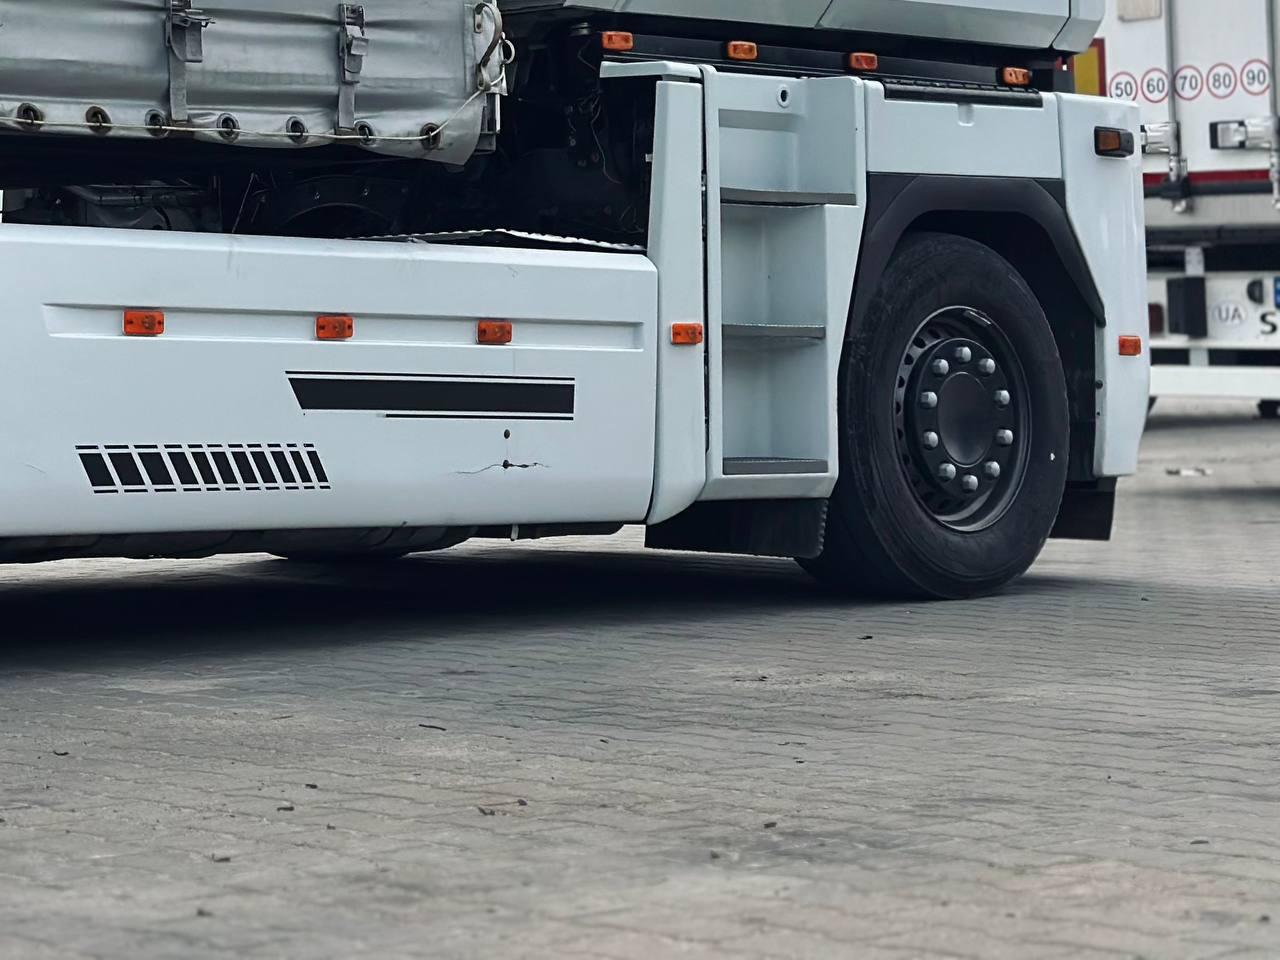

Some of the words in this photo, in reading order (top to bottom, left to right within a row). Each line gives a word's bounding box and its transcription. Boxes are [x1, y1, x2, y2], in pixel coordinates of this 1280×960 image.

[1115, 80, 1133, 98] 50
[1146, 77, 1166, 94] 60
[1179, 74, 1199, 91] 70
[1212, 71, 1232, 89] 80
[1246, 68, 1267, 86] 90
[1218, 305, 1244, 322] UA
